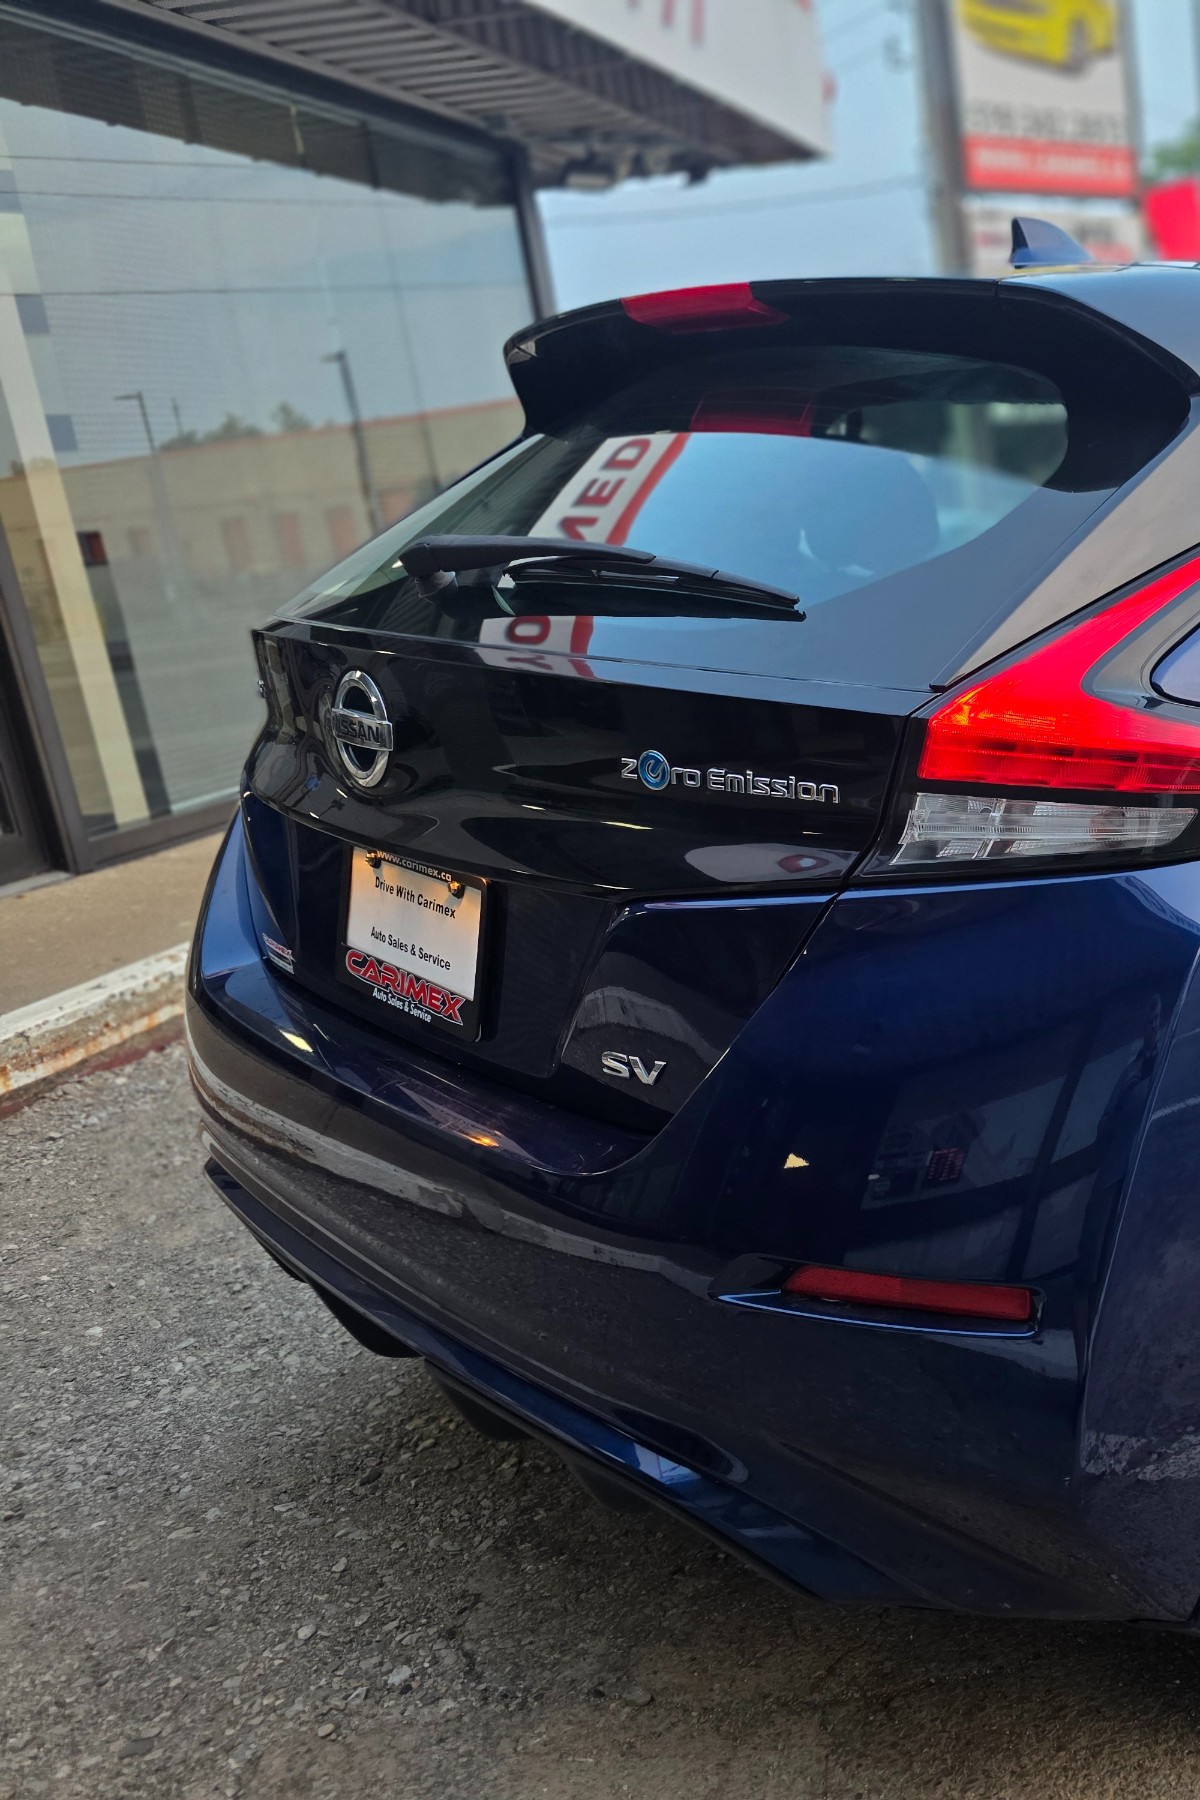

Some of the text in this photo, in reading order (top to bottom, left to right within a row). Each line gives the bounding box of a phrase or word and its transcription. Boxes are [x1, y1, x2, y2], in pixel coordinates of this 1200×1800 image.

[707, 768, 839, 803] Emission
[377, 850, 452, 881] www.carimex.ca
[375, 876, 456, 919] Drive With Carimex
[370, 926, 451, 970] Auto Sales & Service
[346, 950, 465, 1024] CARIMEX
[372, 987, 387, 1002] Auto
[387, 993, 403, 1009] Sales
[410, 1003, 432, 1023] Service
[602, 1051, 667, 1086] SV
